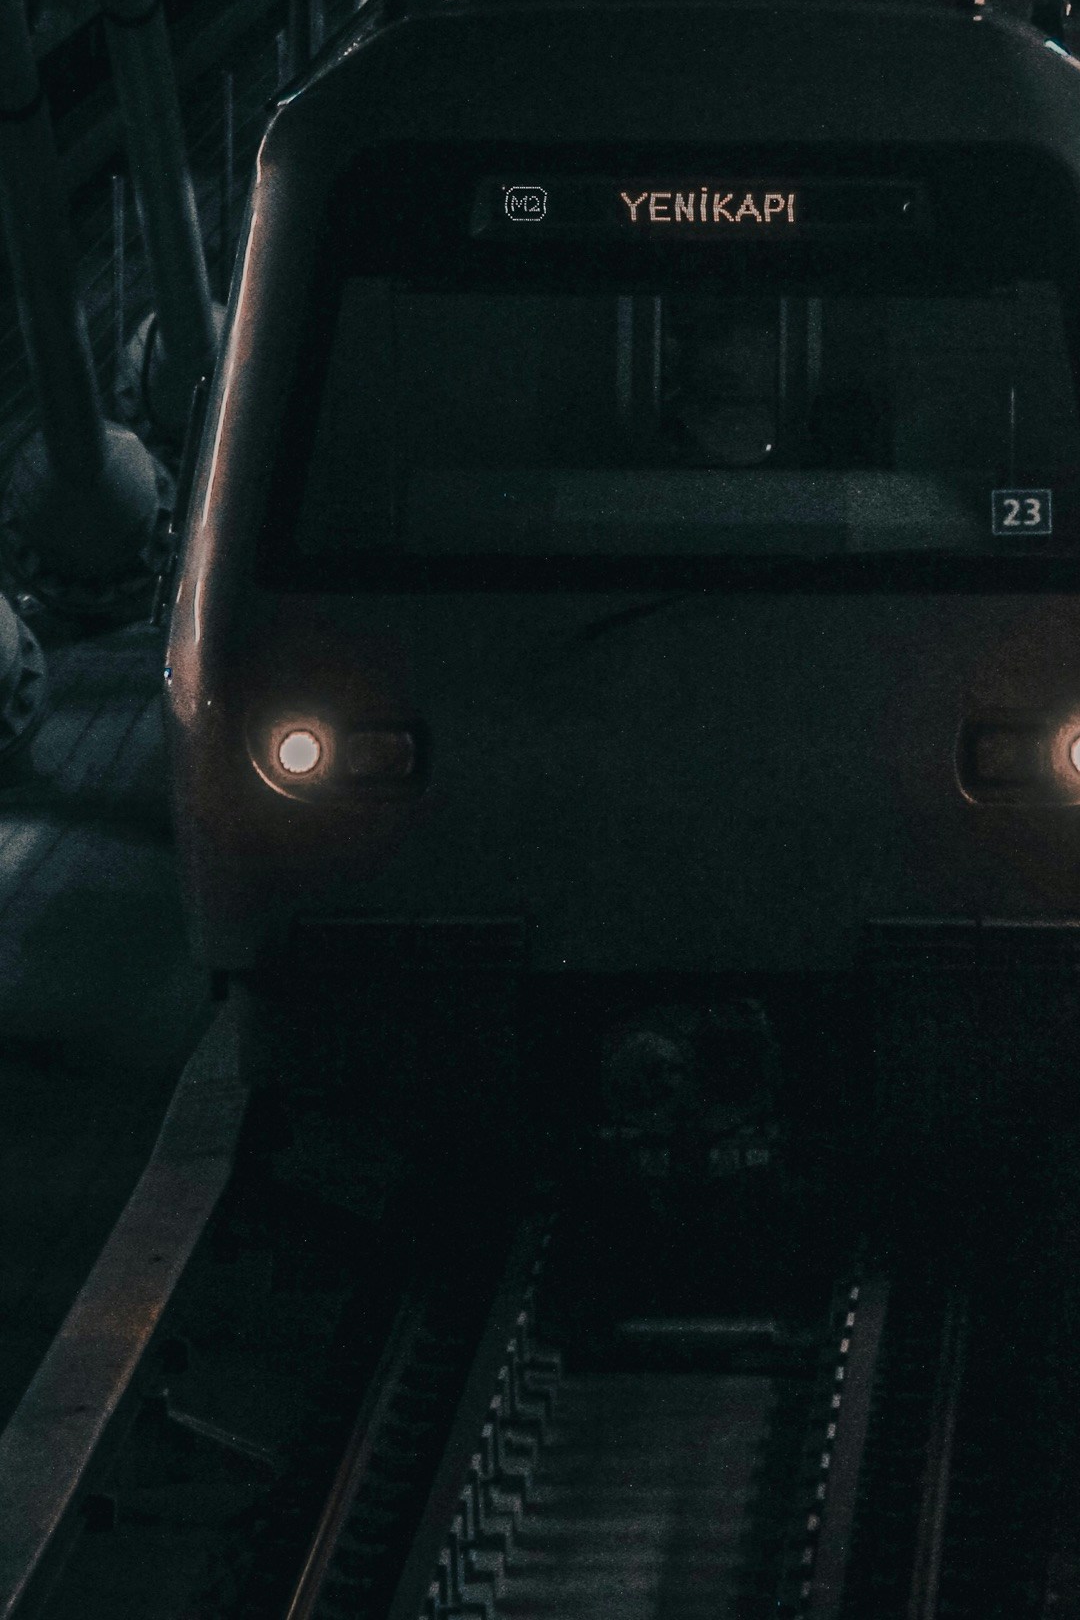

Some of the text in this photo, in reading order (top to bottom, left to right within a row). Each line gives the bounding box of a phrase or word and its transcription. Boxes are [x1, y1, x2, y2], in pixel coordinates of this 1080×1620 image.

[510, 186, 795, 223] M2 YENİKAPI
[1003, 498, 1041, 527] 23
